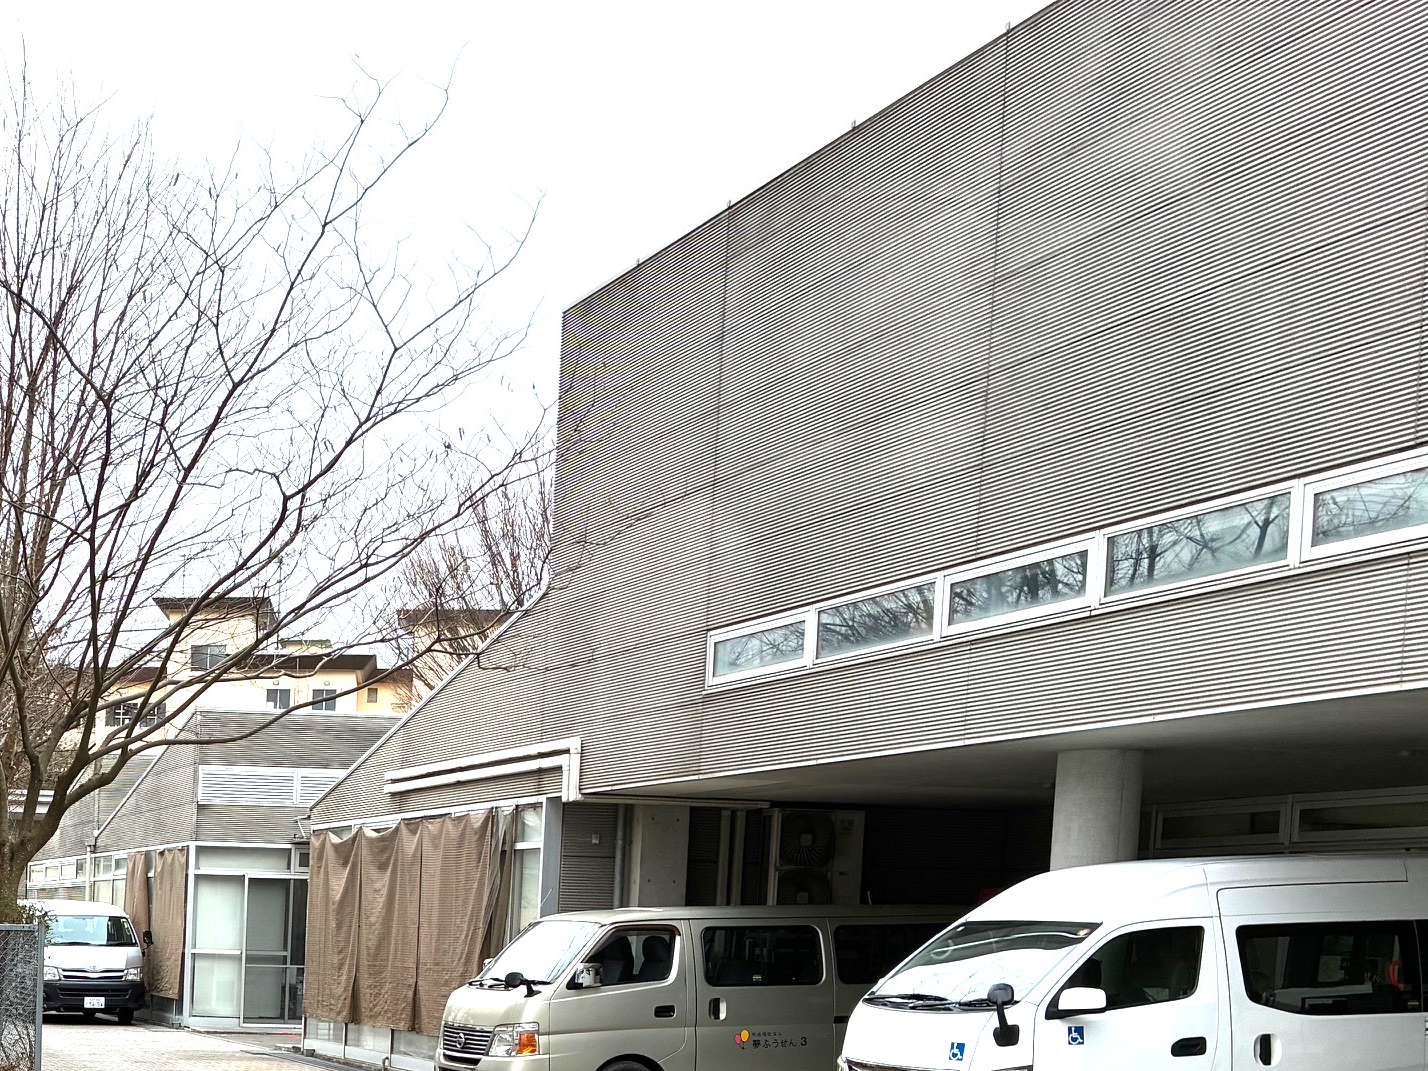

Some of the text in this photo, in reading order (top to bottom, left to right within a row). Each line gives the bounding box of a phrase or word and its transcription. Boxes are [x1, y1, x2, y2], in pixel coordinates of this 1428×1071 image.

[752, 1036, 808, 1049] 夢ふうせん 3
